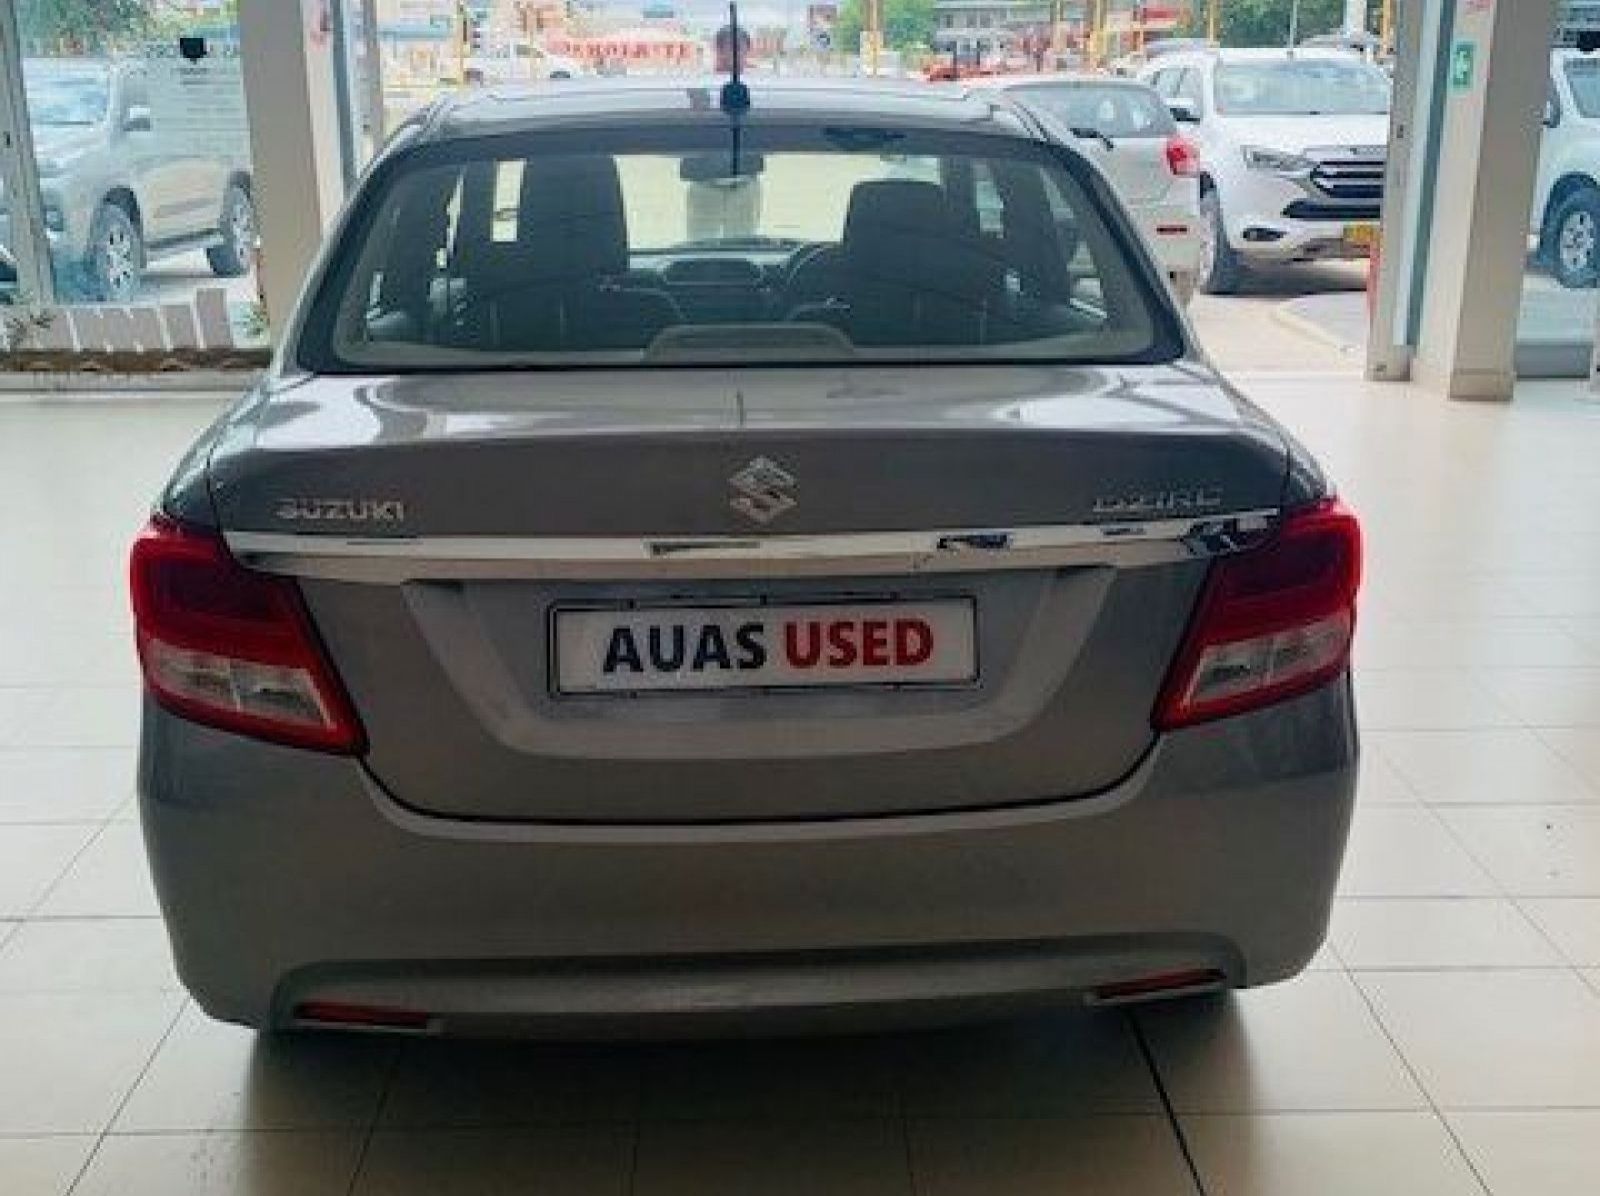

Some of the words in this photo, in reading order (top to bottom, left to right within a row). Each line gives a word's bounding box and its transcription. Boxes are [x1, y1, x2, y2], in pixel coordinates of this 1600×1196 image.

[275, 498, 404, 521] SUZUKI
[603, 622, 767, 672] AUAS
[786, 620, 933, 669] USED
